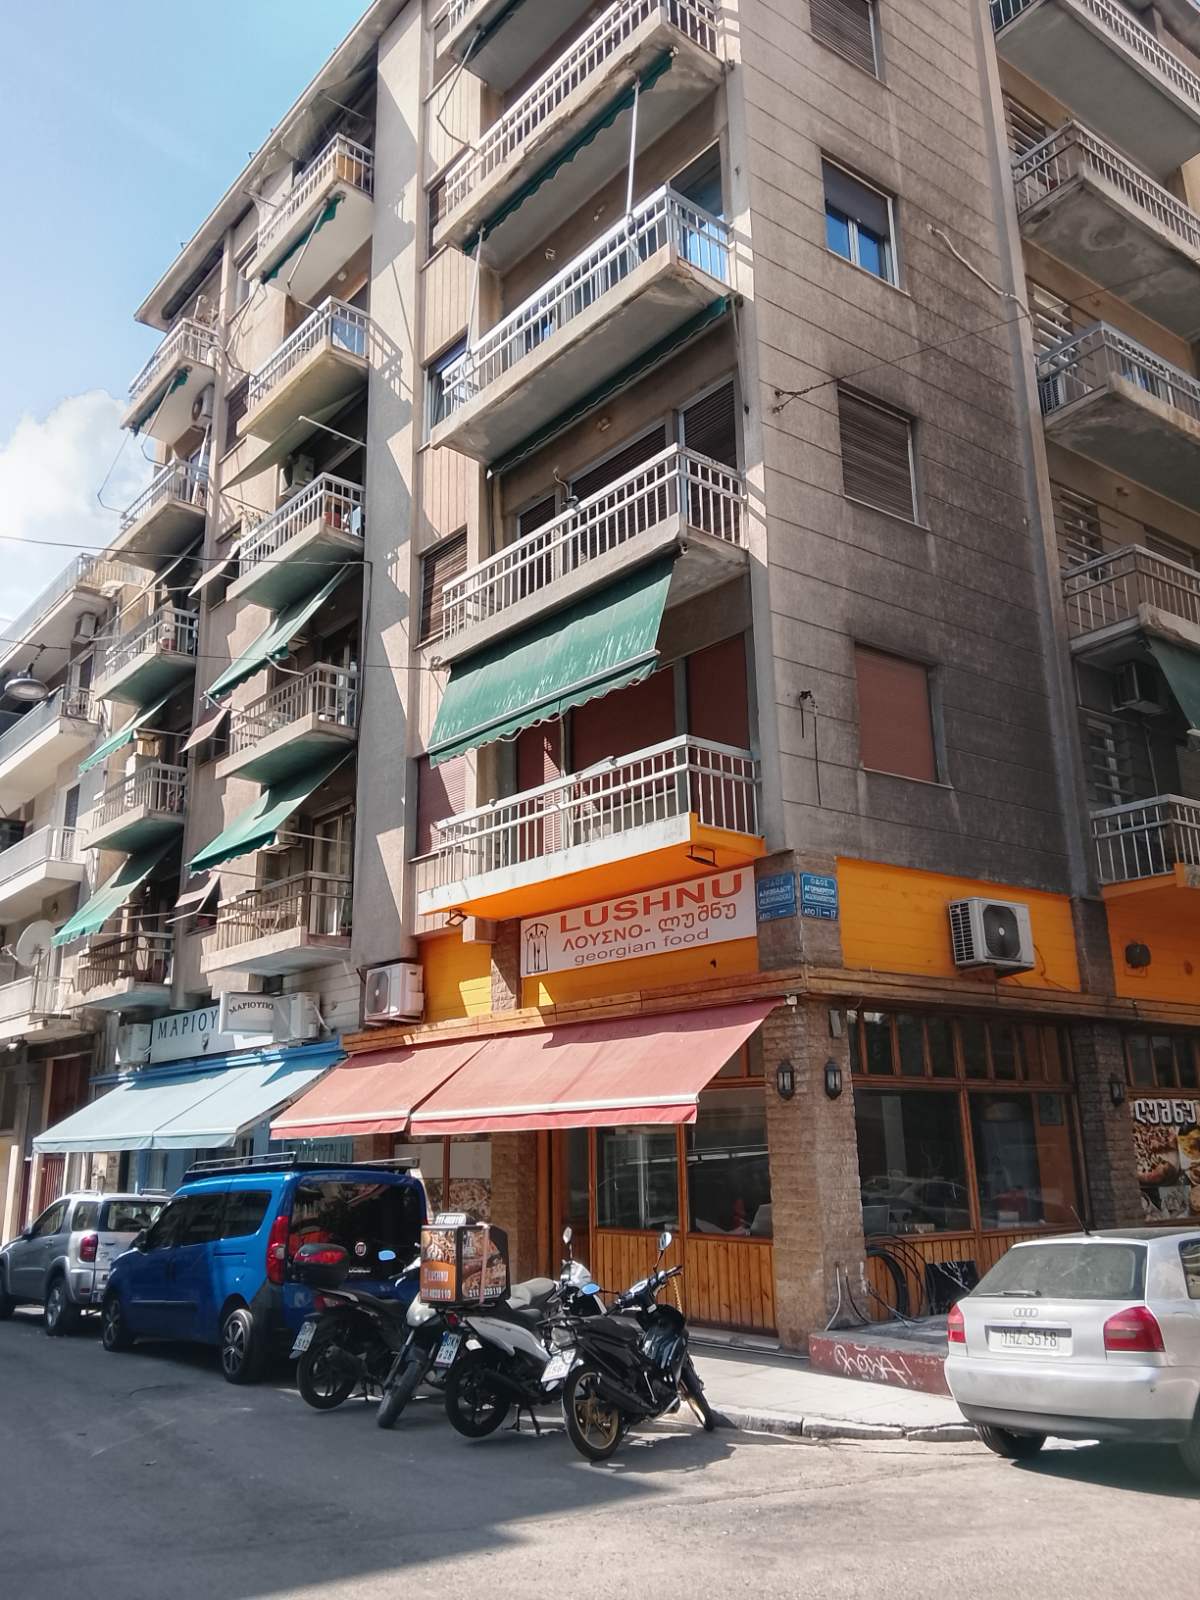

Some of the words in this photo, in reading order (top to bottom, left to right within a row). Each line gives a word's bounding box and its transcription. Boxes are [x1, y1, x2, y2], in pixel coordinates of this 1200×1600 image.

[560, 873, 743, 933] LUSHNU
[658, 901, 737, 934] ლუშნუ
[574, 939, 656, 966] georgian
[664, 928, 709, 947] food
[228, 1001, 274, 1015] ΜΑΡΙΟΥΠΟ
[157, 1010, 218, 1040] ΜΑΡΙΟΥ
